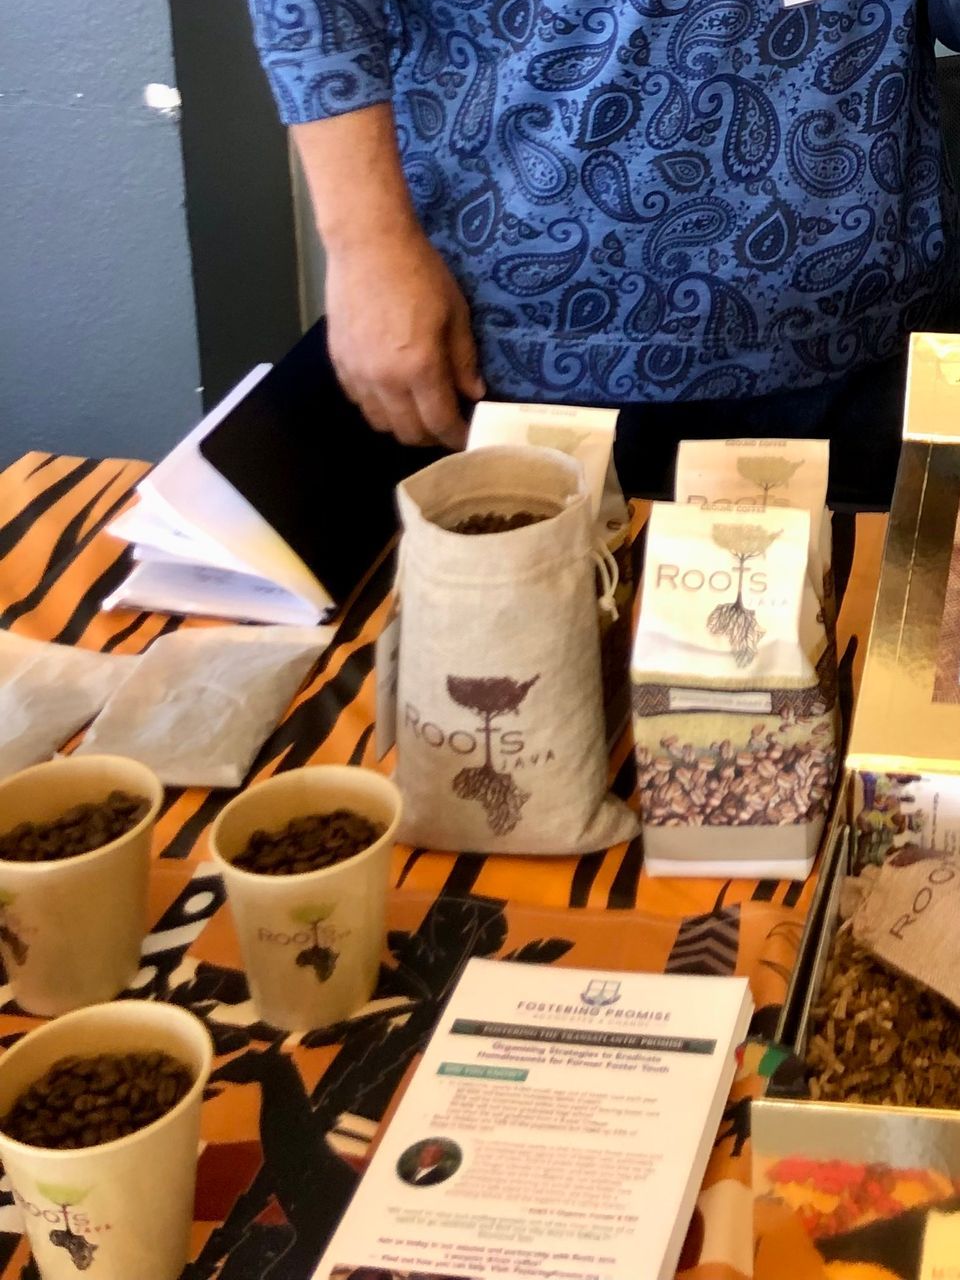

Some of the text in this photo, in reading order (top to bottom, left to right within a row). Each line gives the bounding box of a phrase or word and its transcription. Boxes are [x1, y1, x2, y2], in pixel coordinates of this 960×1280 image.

[501, 749, 556, 770] JAVA
[889, 867, 956, 940] ROO
[516, 1000, 672, 1022] FOSTERING PROMISE
